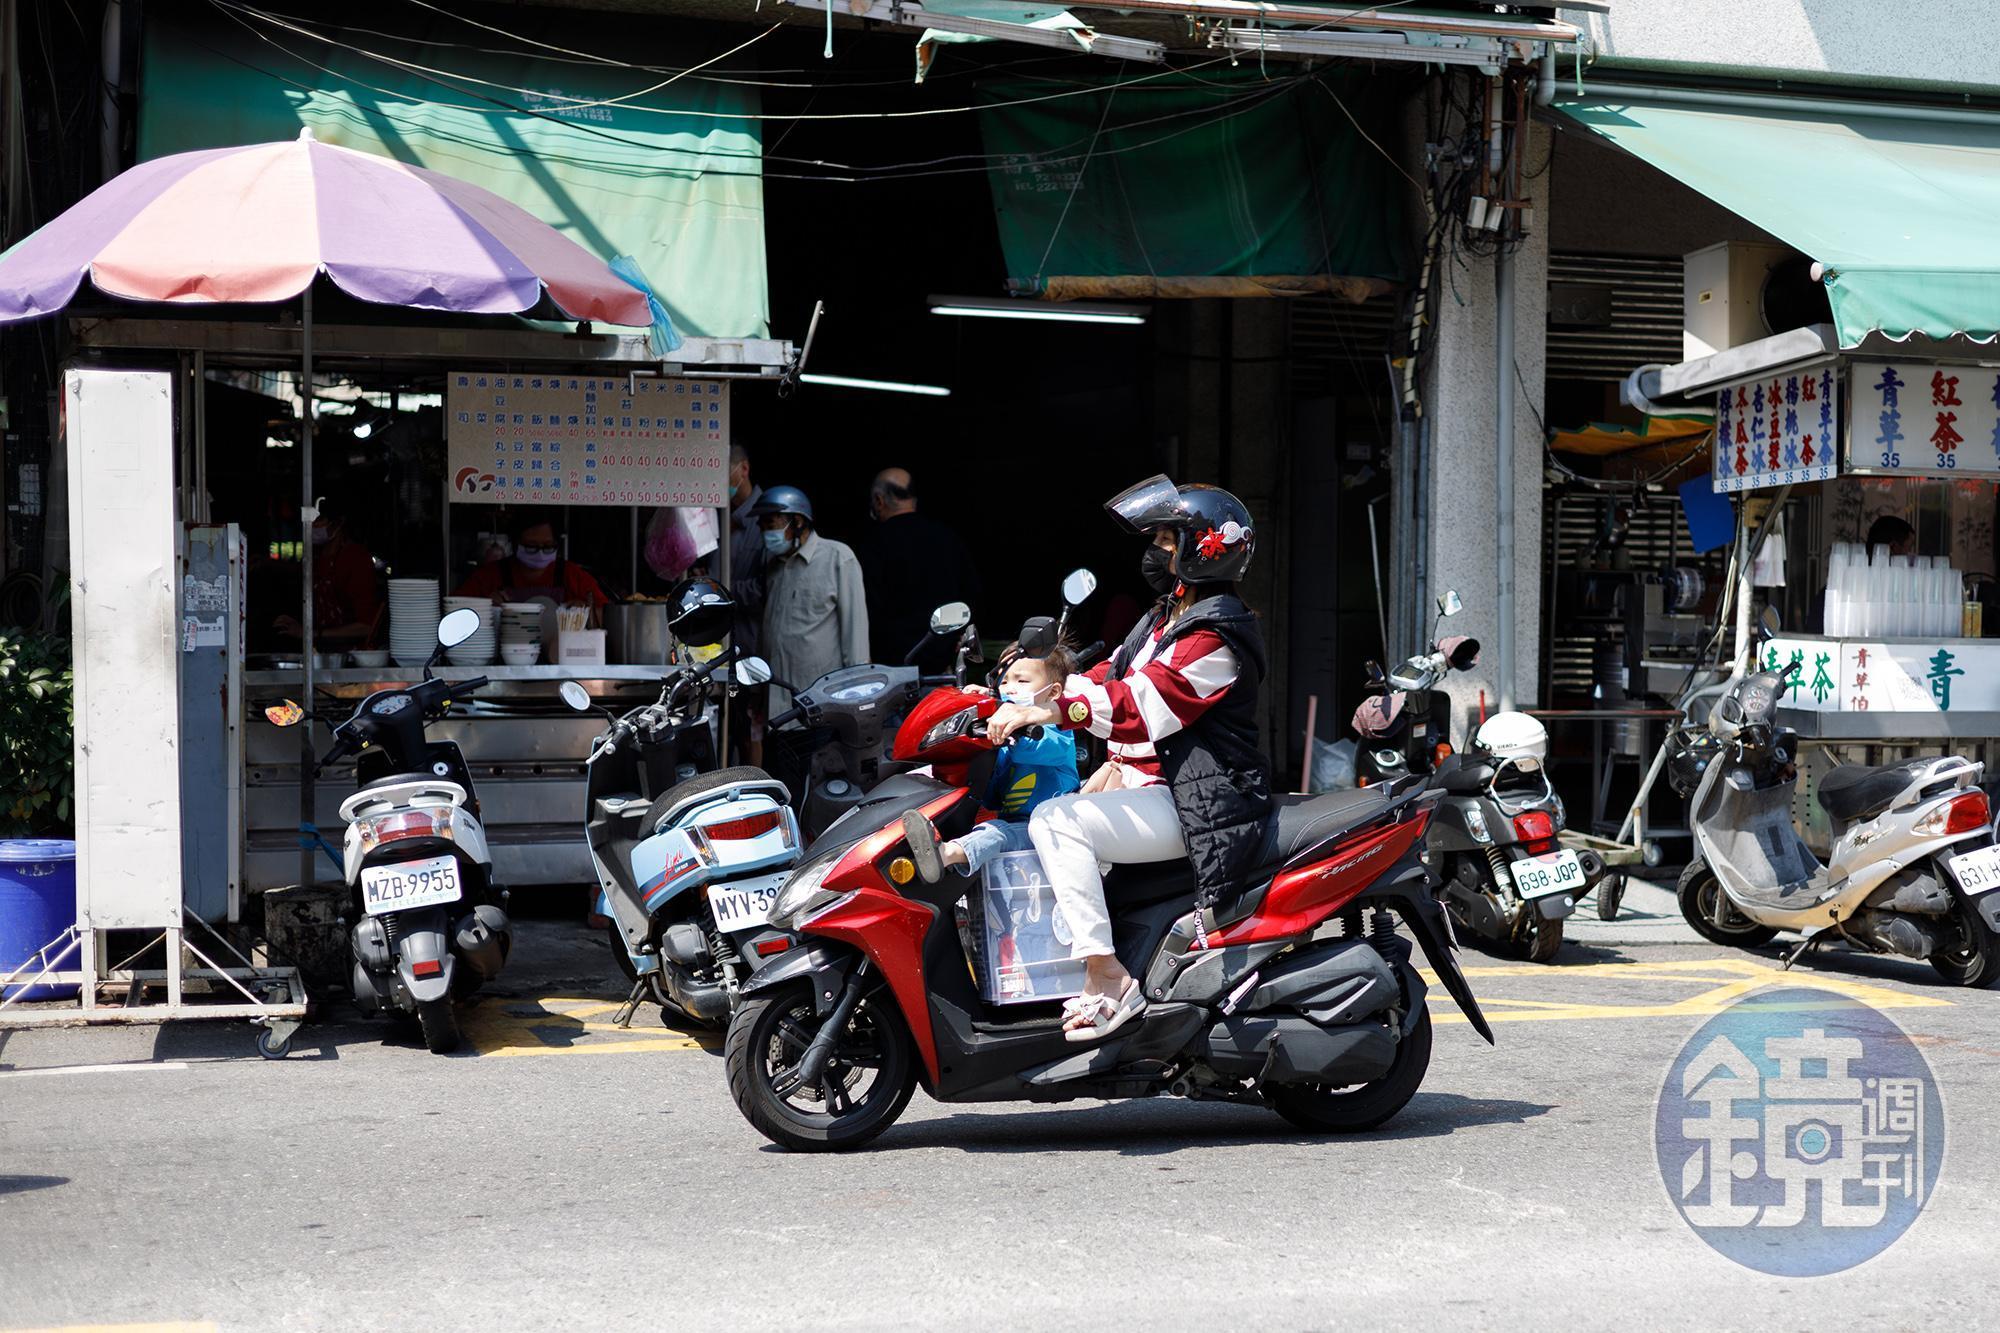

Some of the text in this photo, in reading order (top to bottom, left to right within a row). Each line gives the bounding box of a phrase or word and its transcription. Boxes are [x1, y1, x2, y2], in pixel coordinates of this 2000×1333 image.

[1874, 367, 1905, 452] 青草
[1929, 370, 1964, 454] 紅茶
[1784, 376, 1799, 469] 楊桃冰
[1818, 369, 1834, 466] 青草茶
[1751, 384, 1766, 475] 杏仁冰
[602, 455, 615, 466] 40
[620, 456, 633, 466] 40
[637, 456, 650, 466] 40
[655, 456, 668, 467] 40
[672, 457, 686, 468] 40
[690, 458, 703, 468] 40
[707, 458, 720, 468] 40
[1881, 453, 1900, 468] 35
[1936, 453, 1956, 469] 35
[1768, 473, 1778, 486] 35
[1784, 471, 1794, 484] 35
[1801, 469, 1810, 482] 35
[1819, 467, 1828, 481] 35
[1720, 480, 1729, 492] 55
[1735, 478, 1744, 490] 35
[1751, 476, 1760, 488] 35
[602, 491, 615, 502] 50
[620, 491, 633, 502] 50
[637, 492, 650, 502] 50
[655, 492, 668, 502] 50
[672, 492, 686, 503] 50
[690, 493, 703, 503] 50
[707, 493, 720, 504] 50
[1926, 648, 1965, 711] 青
